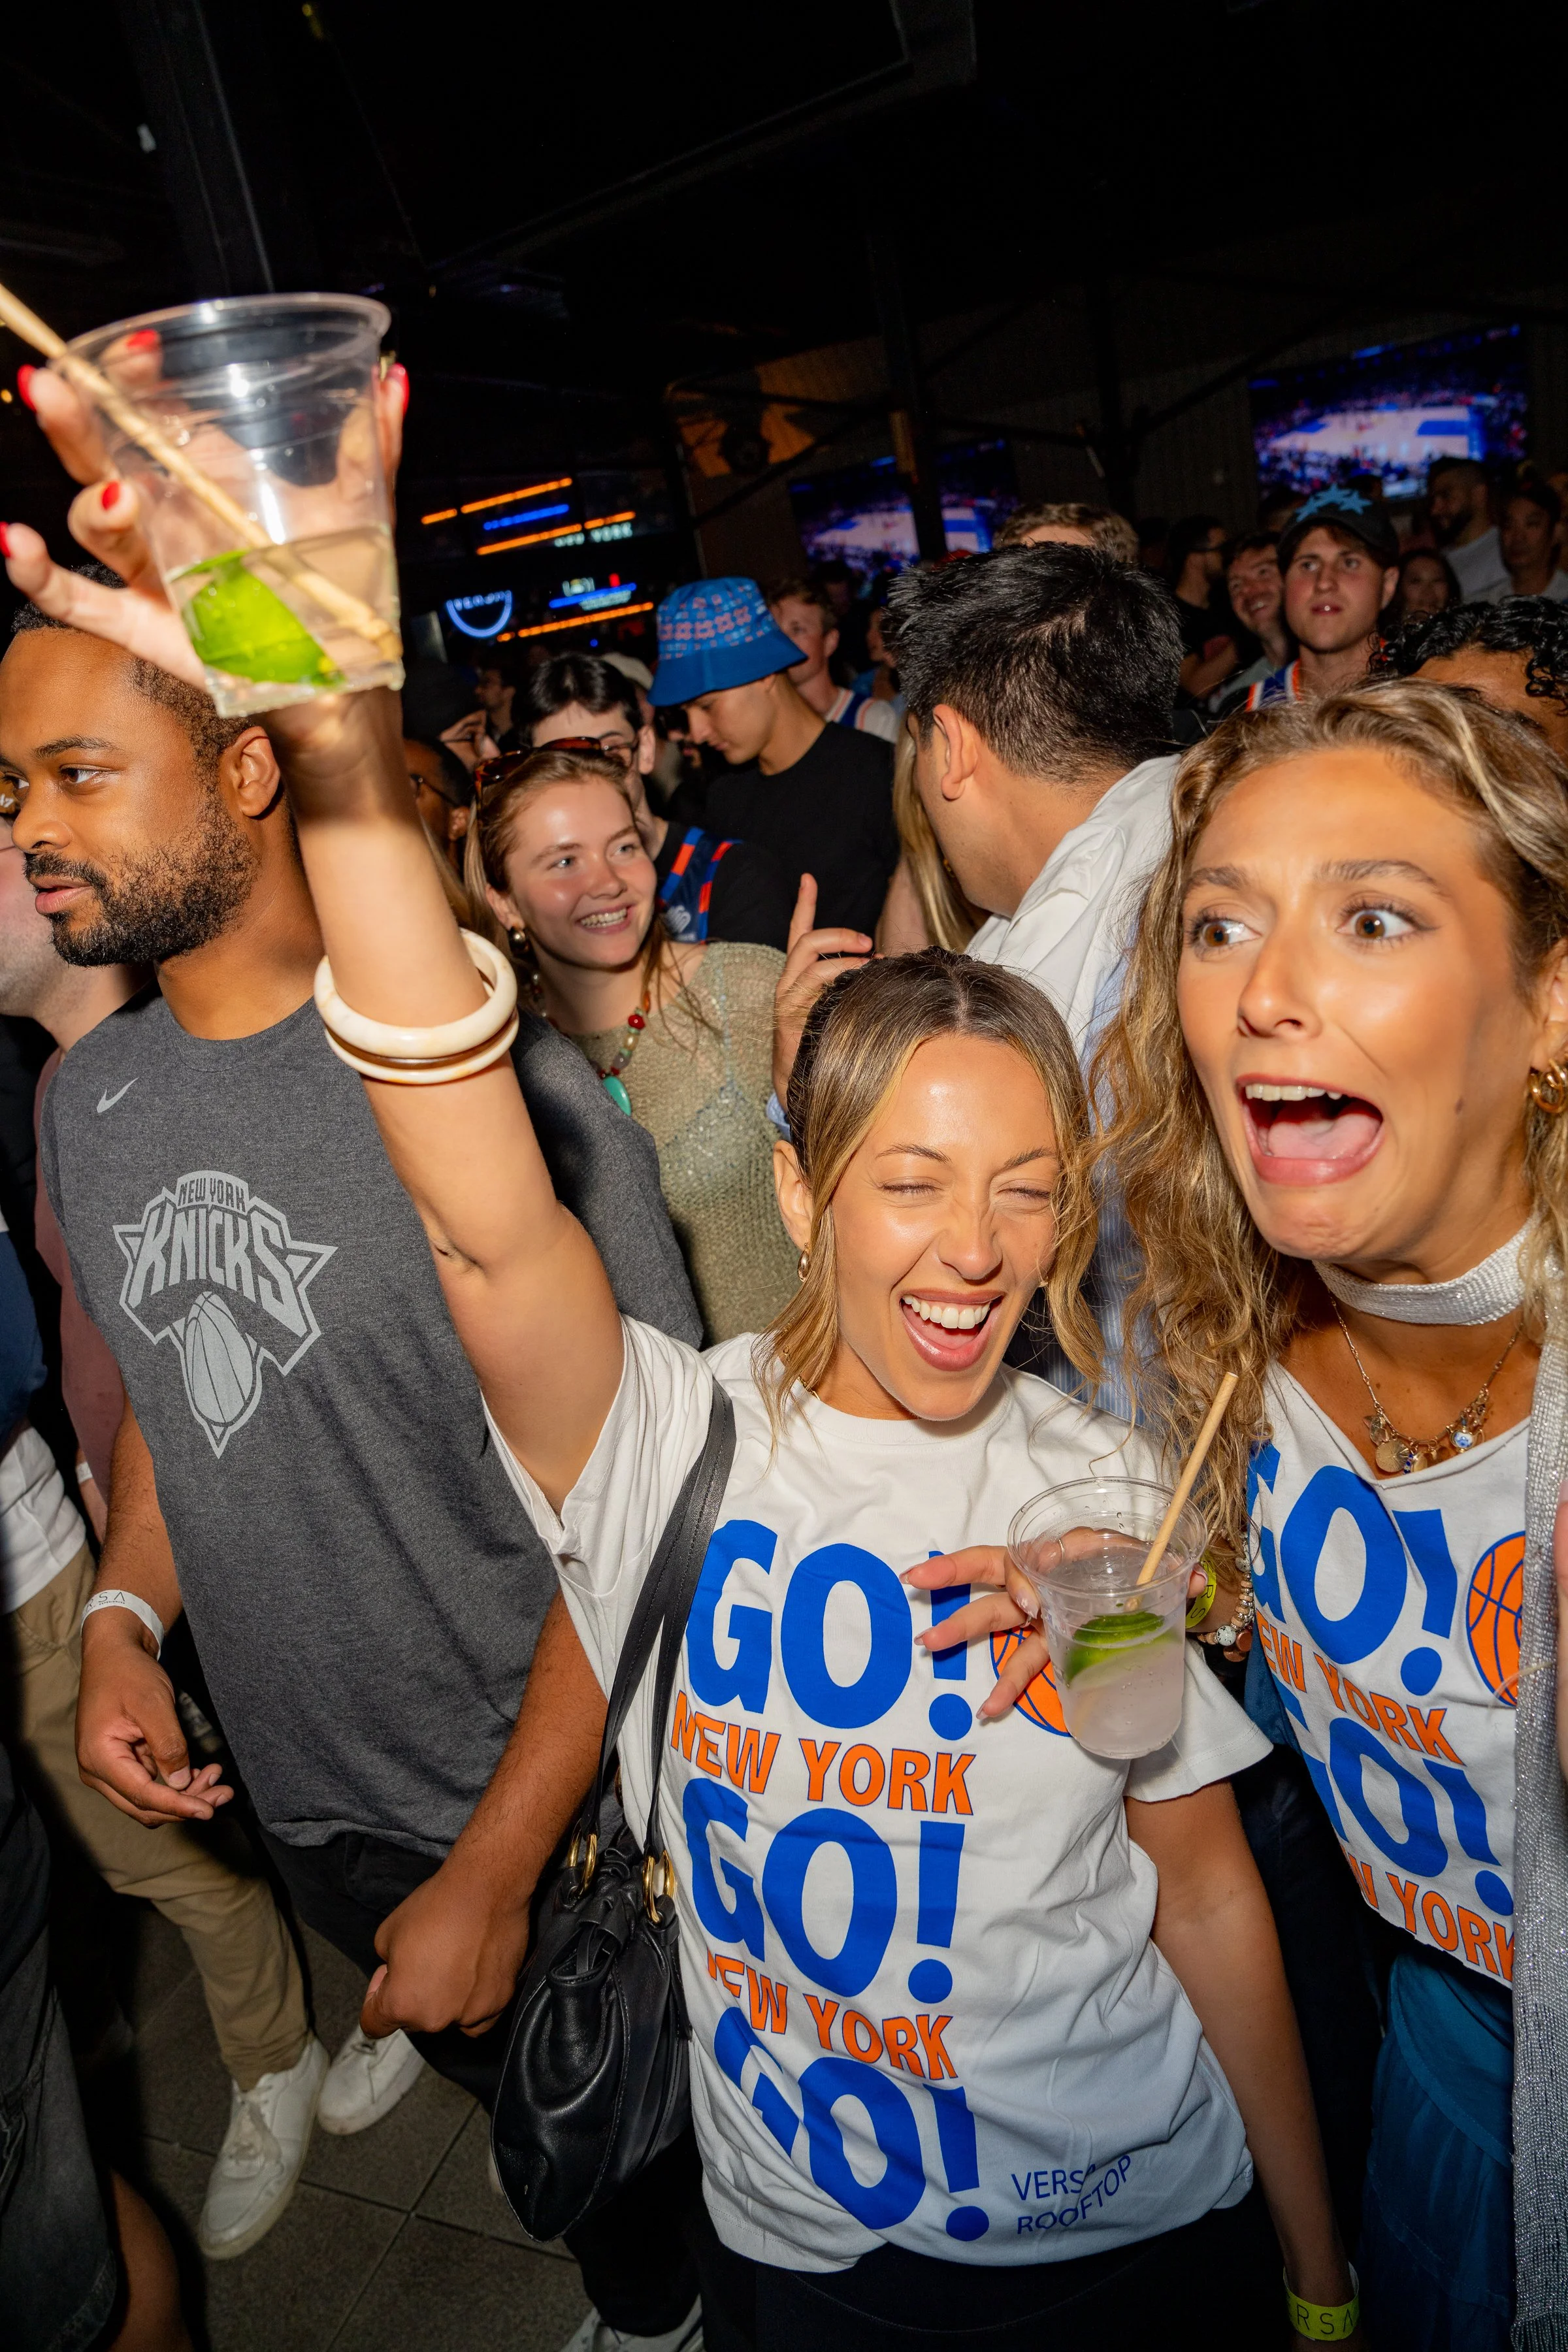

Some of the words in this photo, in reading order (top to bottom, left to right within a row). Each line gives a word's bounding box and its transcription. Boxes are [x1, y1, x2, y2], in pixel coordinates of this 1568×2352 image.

[178, 1178, 206, 1207] NEW
[209, 1178, 246, 1213] YORK
[126, 1201, 313, 1337] KNICKS
[685, 1519, 973, 1741] GO!
[1256, 1608, 1307, 1693] EW
[1313, 1652, 1467, 1766] YORK
[670, 1690, 781, 1795] NEW
[798, 1738, 977, 1816] YORK
[682, 1777, 966, 2004] GO!
[1385, 1871, 1515, 1982] YORK
[802, 1993, 958, 2080] YORK
[1017, 2155, 1131, 2234] ROOFTOP
